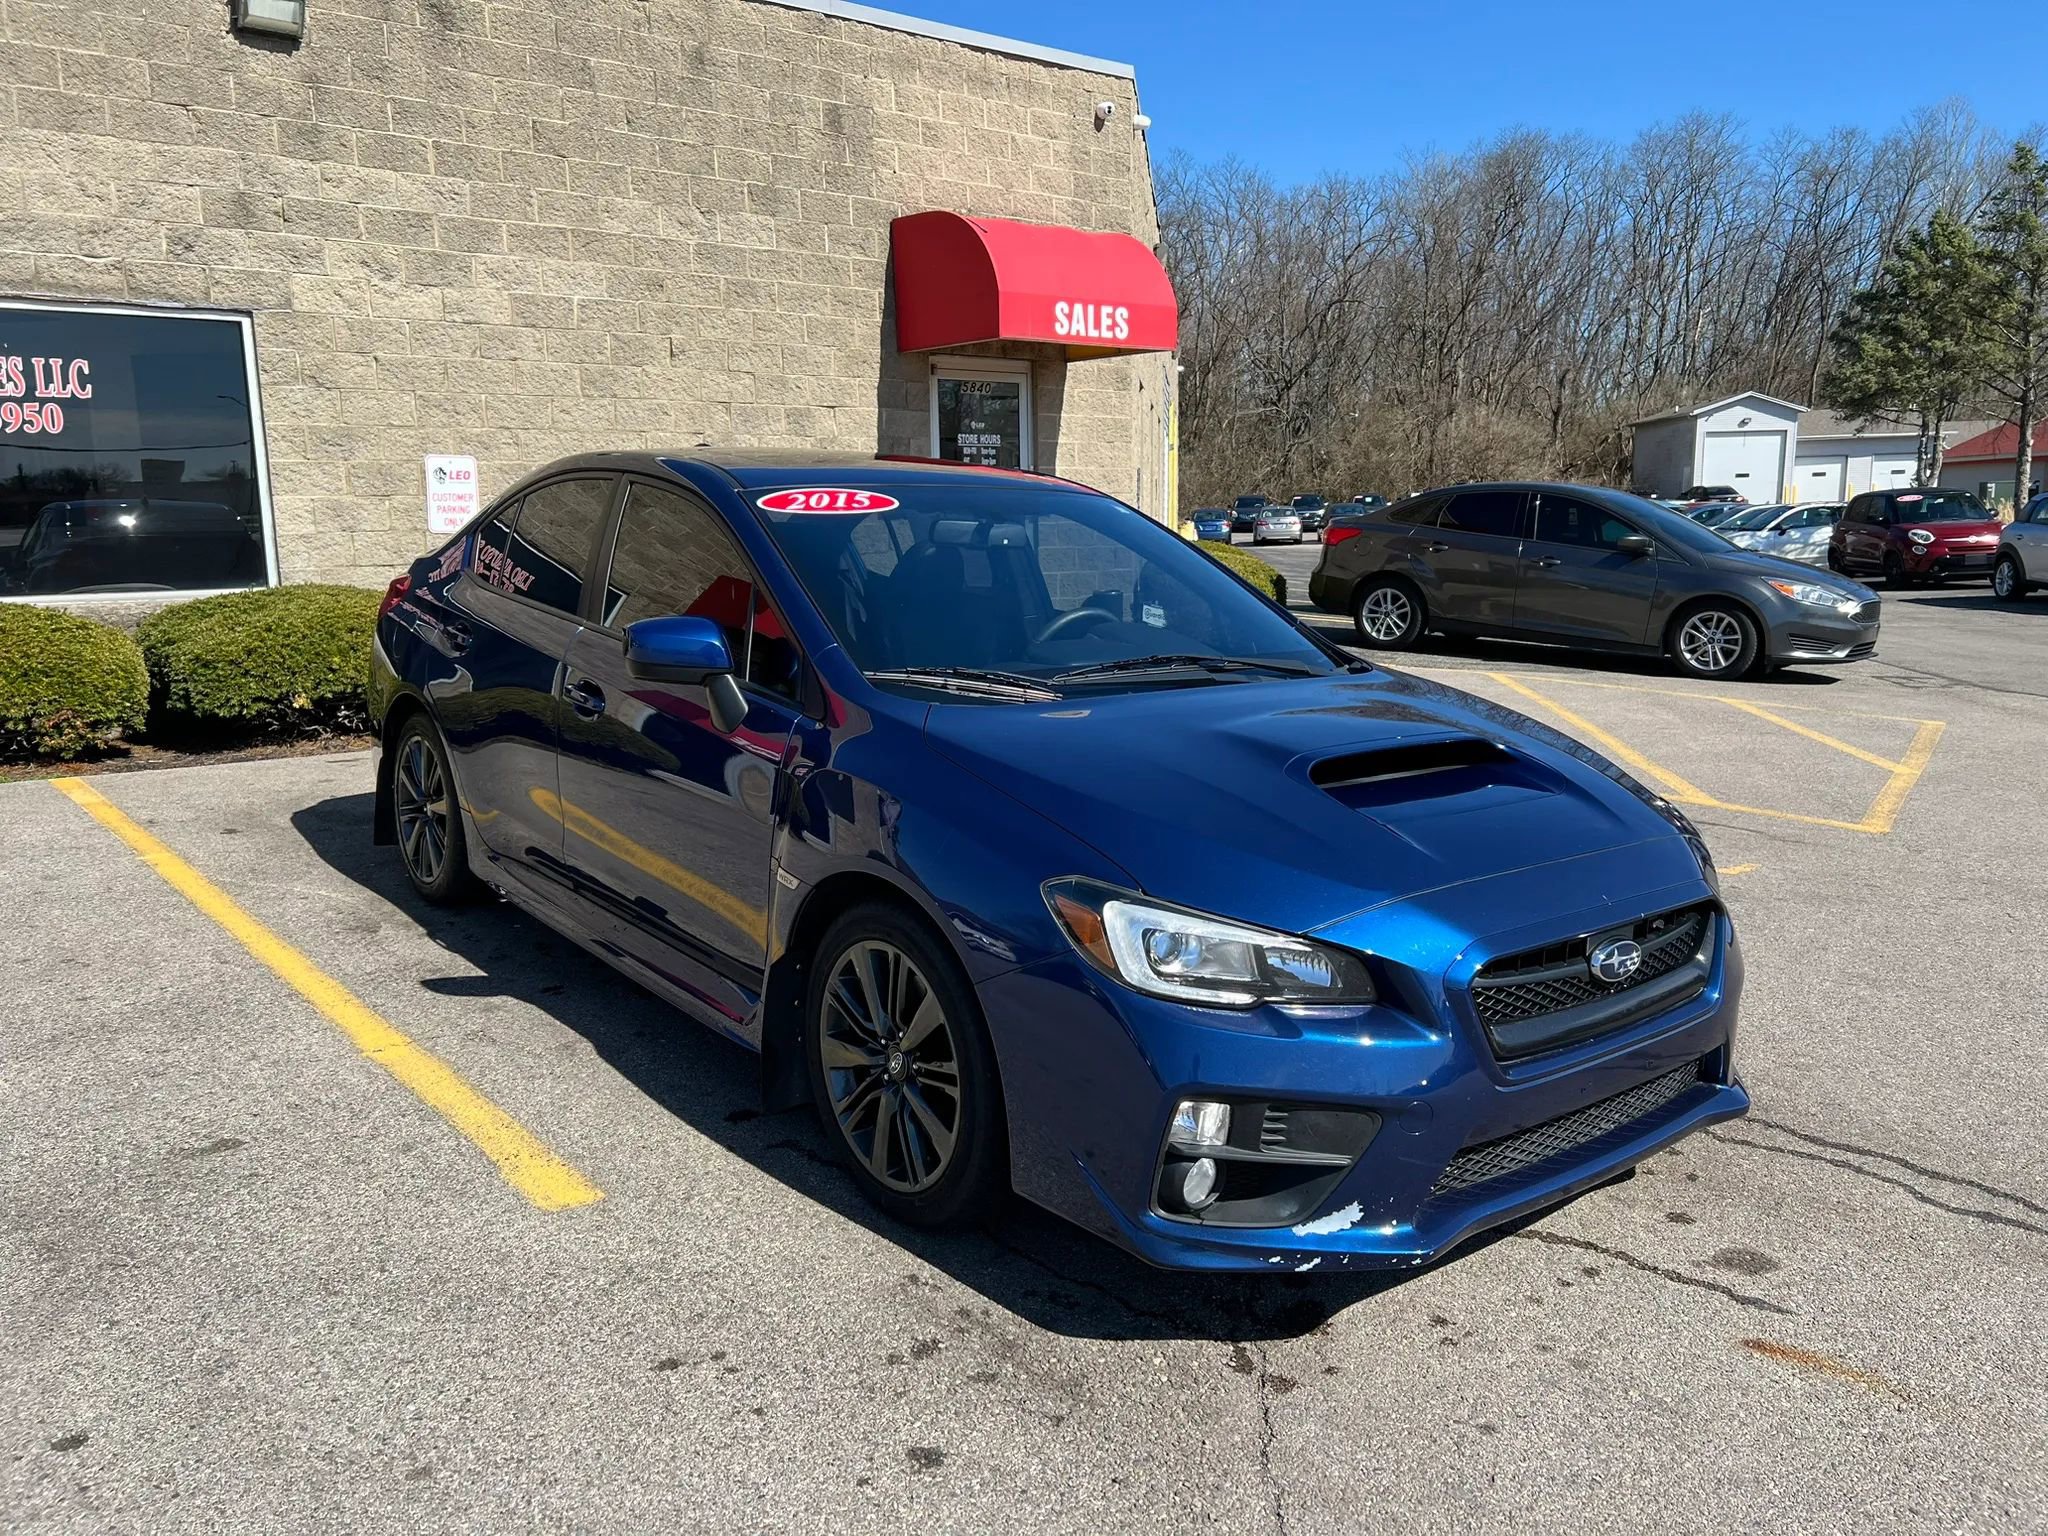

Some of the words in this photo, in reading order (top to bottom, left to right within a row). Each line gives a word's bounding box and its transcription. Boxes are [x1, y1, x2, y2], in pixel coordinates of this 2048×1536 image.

[1055, 301, 1129, 340] SALES
[31, 357, 92, 399] LLC
[962, 381, 992, 394] 5840
[0, 401, 64, 434] 950
[958, 433, 978, 444] STORE
[980, 434, 1001, 444] HOURS
[449, 470, 471, 481] LEO
[432, 493, 475, 502] CUSTOMER
[785, 492, 871, 510] 2015
[436, 505, 471, 514] PARKING
[444, 517, 464, 527] ONLY
[778, 872, 794, 887] WRX
